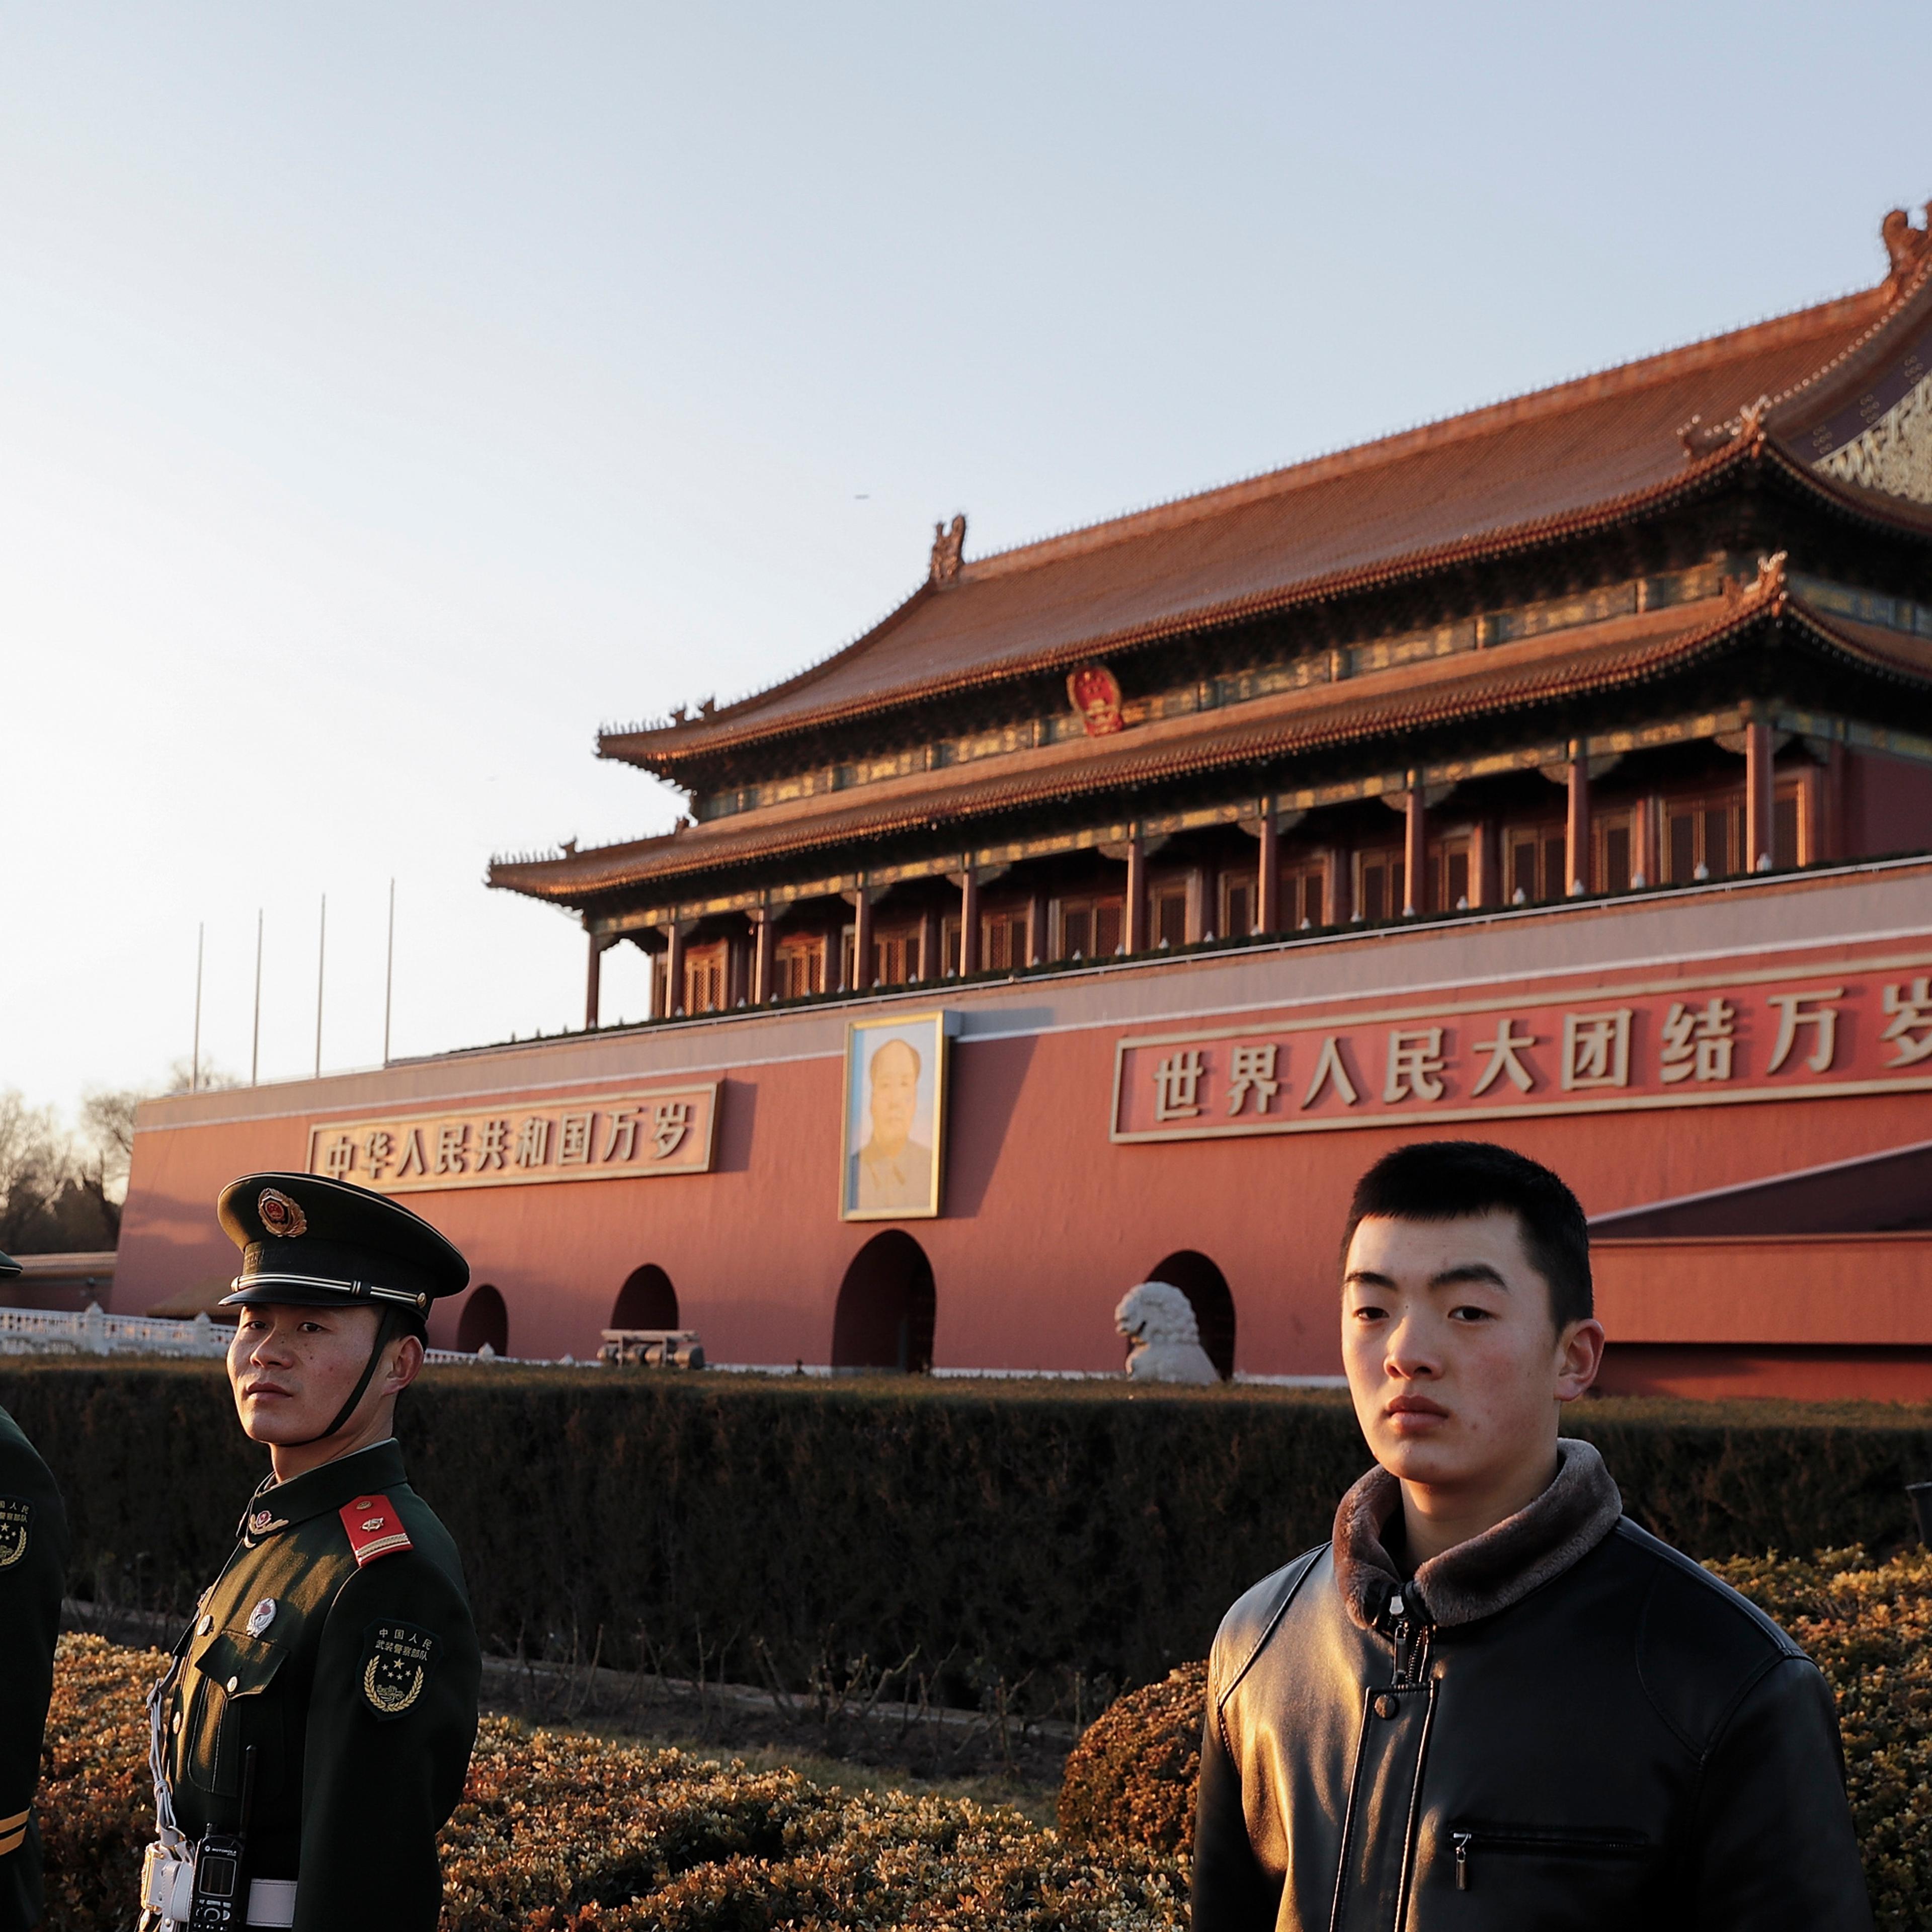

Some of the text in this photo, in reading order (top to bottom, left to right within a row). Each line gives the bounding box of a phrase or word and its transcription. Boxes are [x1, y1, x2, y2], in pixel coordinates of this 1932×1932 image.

[1152, 977, 1932, 1122] 世界人民大团结万岁
[327, 1102, 686, 1180] 中华人民共和国万岁
[379, 1628, 432, 1650] 中国人民
